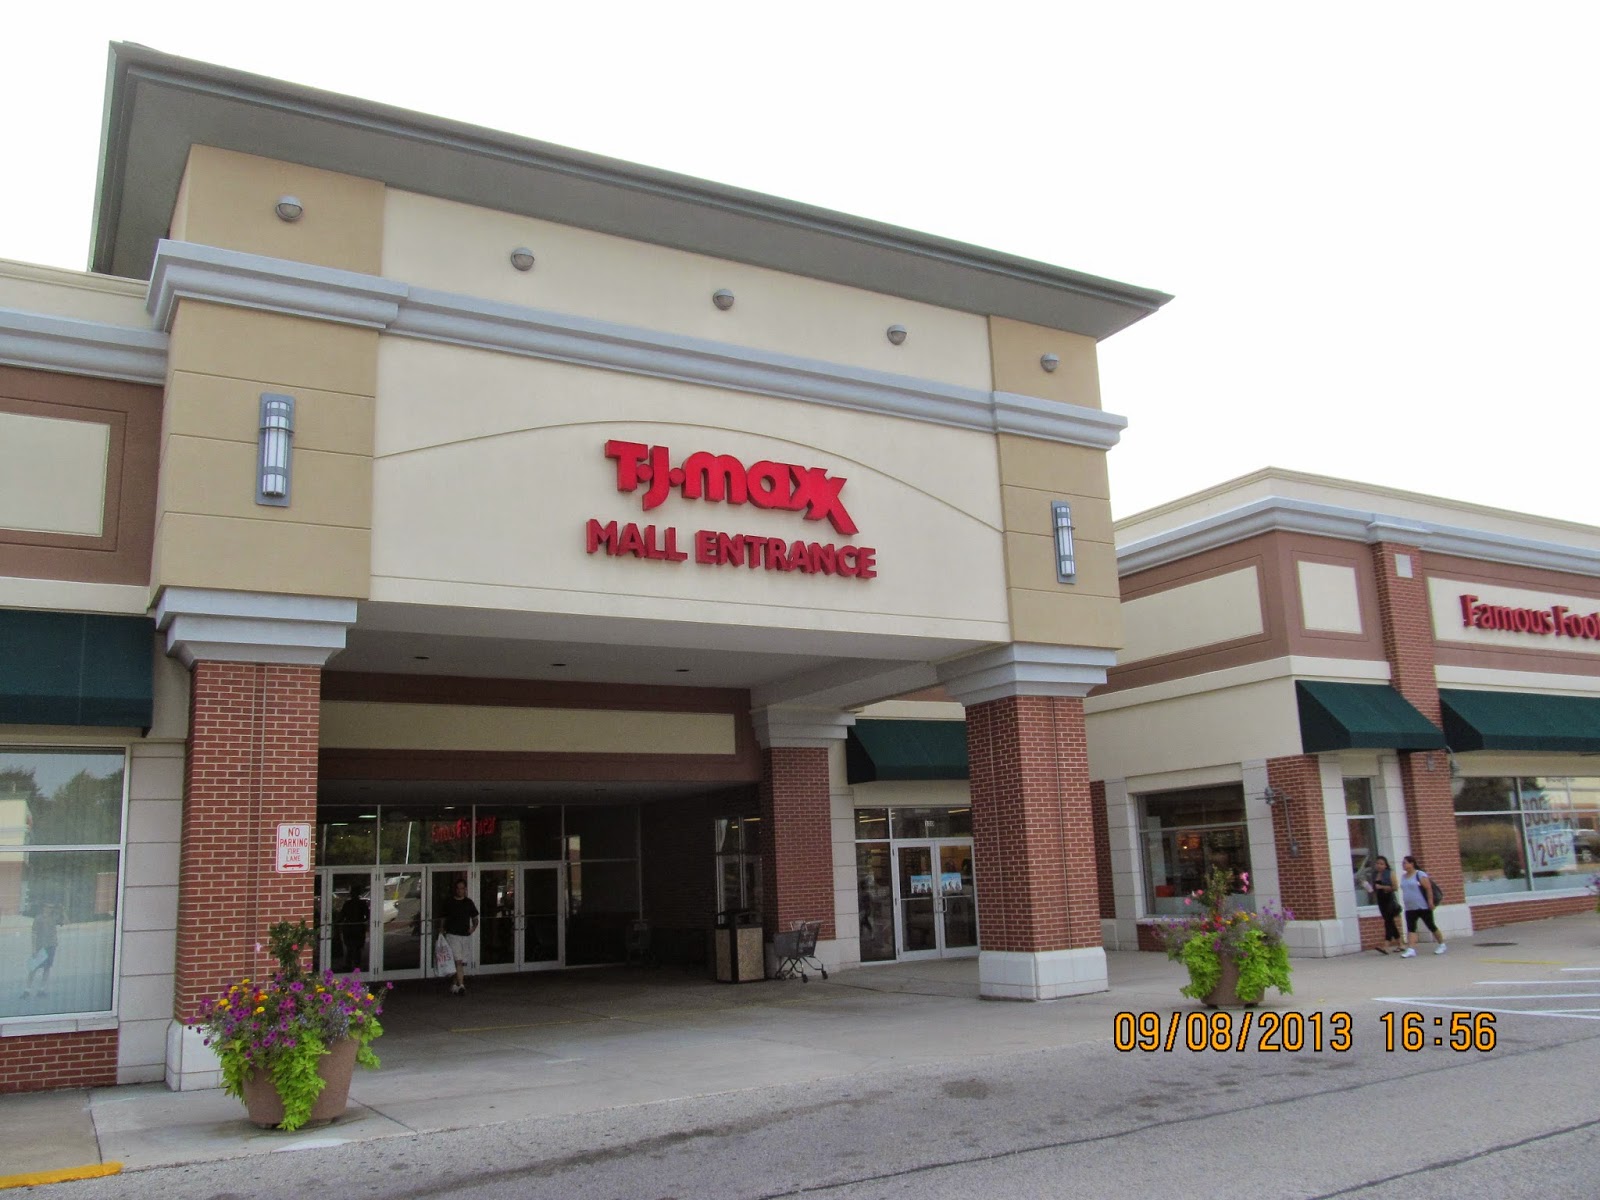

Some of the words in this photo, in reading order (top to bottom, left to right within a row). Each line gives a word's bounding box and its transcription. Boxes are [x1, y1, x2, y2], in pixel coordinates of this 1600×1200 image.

[586, 518, 688, 562] MALL
[695, 529, 877, 579] ENTRANCE
[1459, 594, 1555, 635] Famous
[288, 827, 300, 837] NO
[280, 838, 308, 848] PARKING
[287, 847, 300, 855] FIRE
